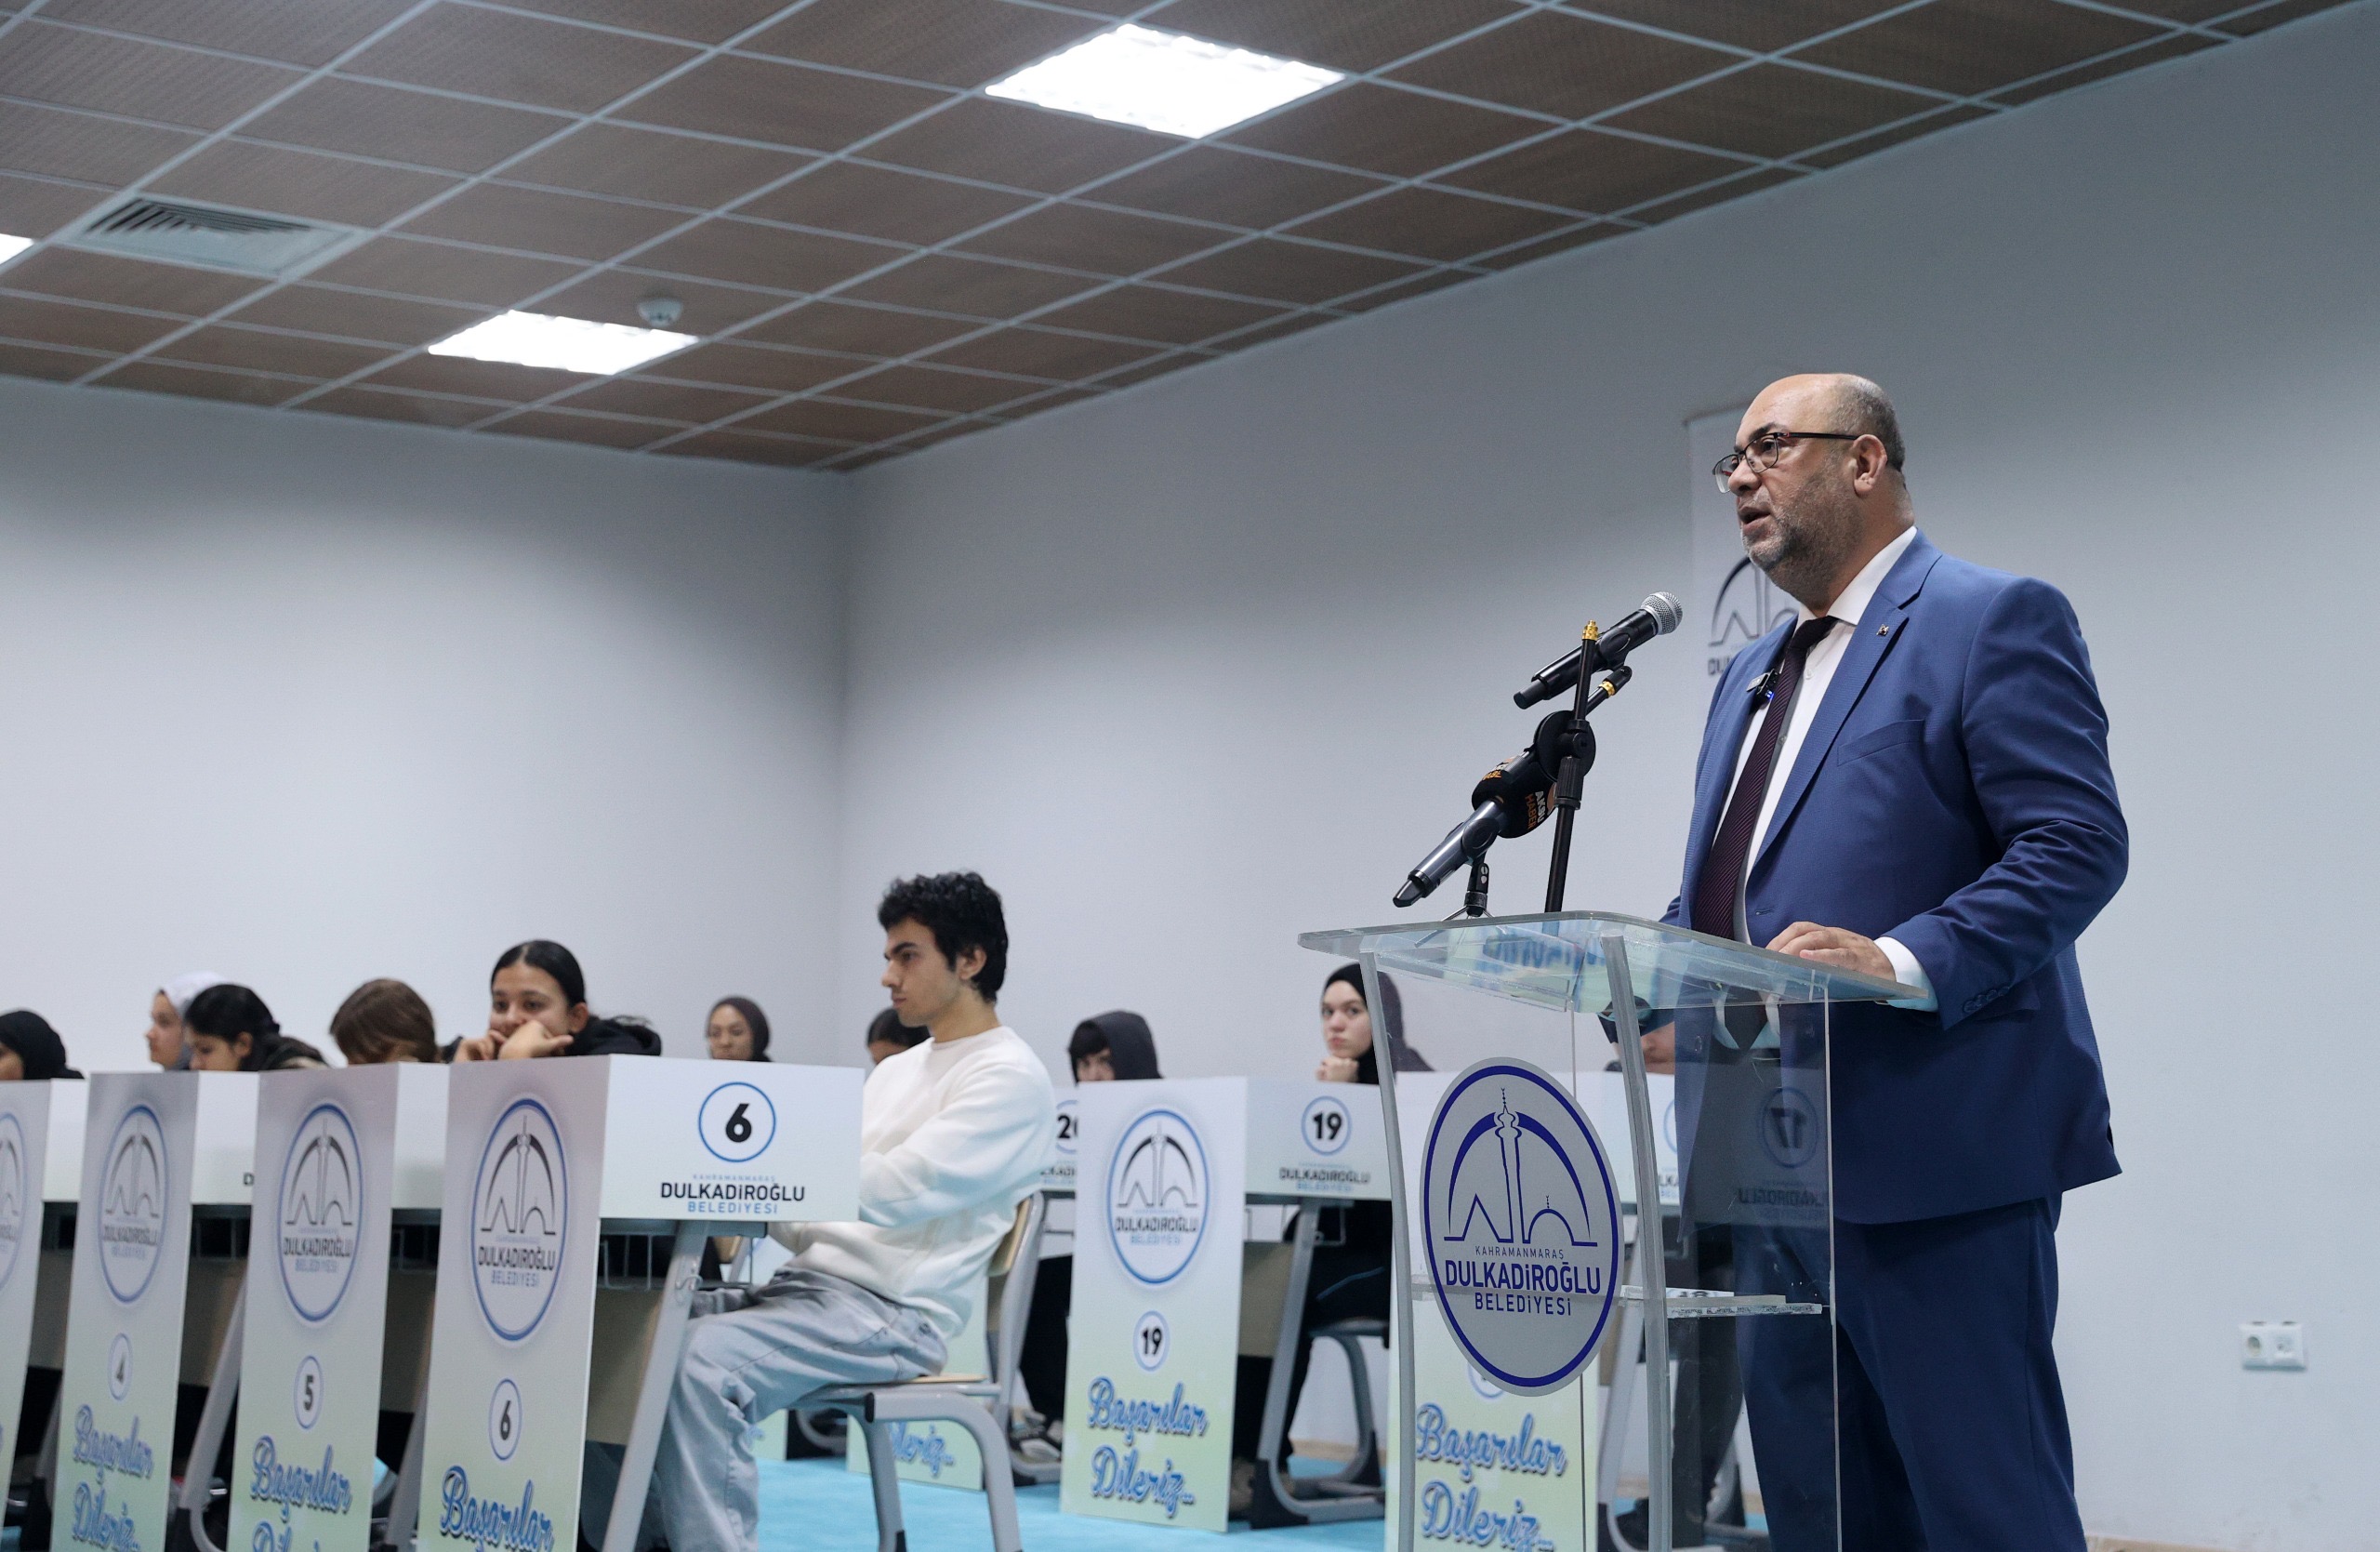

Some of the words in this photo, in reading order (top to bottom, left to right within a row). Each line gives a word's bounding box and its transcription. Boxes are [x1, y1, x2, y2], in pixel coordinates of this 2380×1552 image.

[1525, 794, 1537, 829] HABER
[1535, 790, 1545, 823] AKSU
[725, 1103, 752, 1143] 6
[1313, 1111, 1342, 1140] 19
[661, 1183, 805, 1201] DULKADİROĞLU
[1474, 1245, 1564, 1260] KAHRAMANMARAŞ
[1445, 1259, 1601, 1295] DULKADİROĞLU
[1474, 1292, 1571, 1316] BELEDİYESİ
[1142, 1327, 1162, 1356] 19
[115, 1356, 126, 1385] 4
[303, 1374, 315, 1411] 5
[499, 1399, 511, 1440] 6
